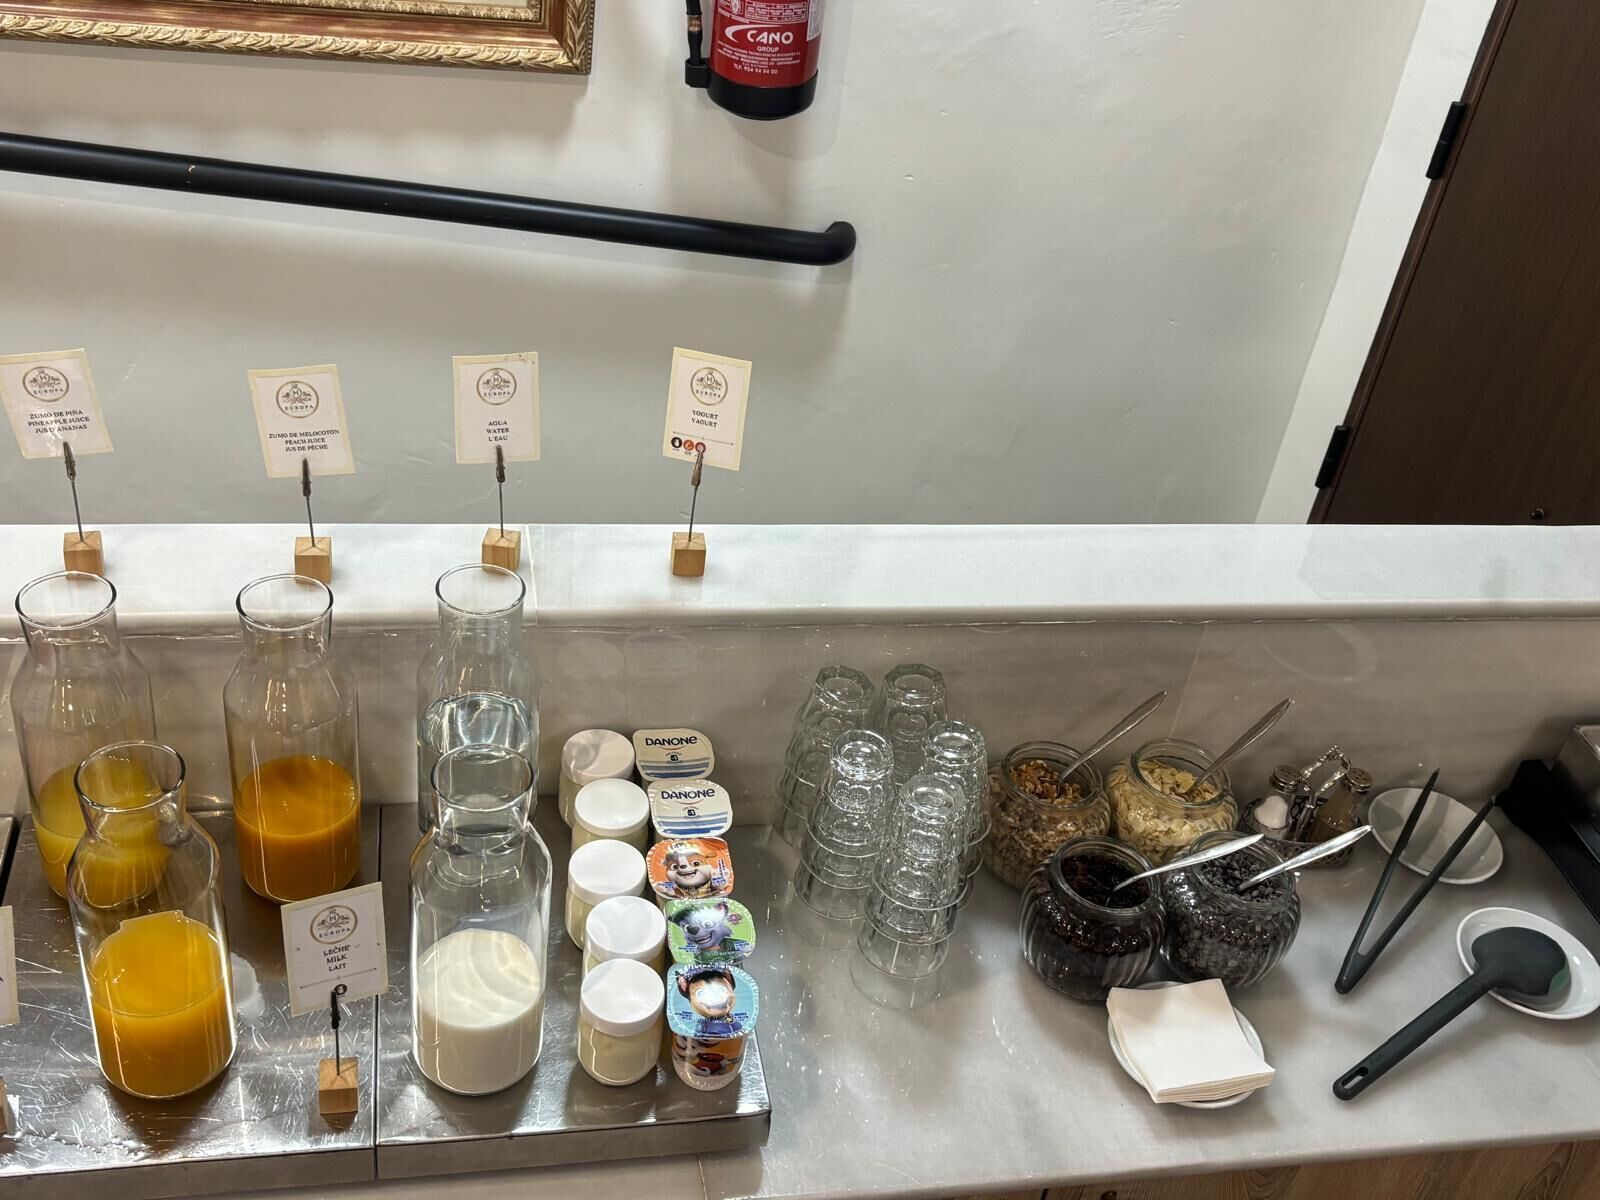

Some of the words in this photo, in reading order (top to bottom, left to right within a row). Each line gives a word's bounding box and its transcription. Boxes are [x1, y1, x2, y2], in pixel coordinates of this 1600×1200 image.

[747, 30, 794, 45] CANO
[695, 389, 721, 398] EUROPA
[29, 411, 53, 420] ZUMO
[53, 410, 65, 418] DE
[65, 409, 84, 417] PIÑA
[692, 409, 719, 420] YOGURT
[27, 418, 68, 427] PINEAPPLE
[68, 416, 90, 424] JUICE
[691, 417, 718, 428] YAOURT
[319, 927, 350, 937] EUROPA
[323, 946, 350, 956] LECHE
[326, 953, 347, 964] MILK
[328, 963, 347, 971] LAIT
